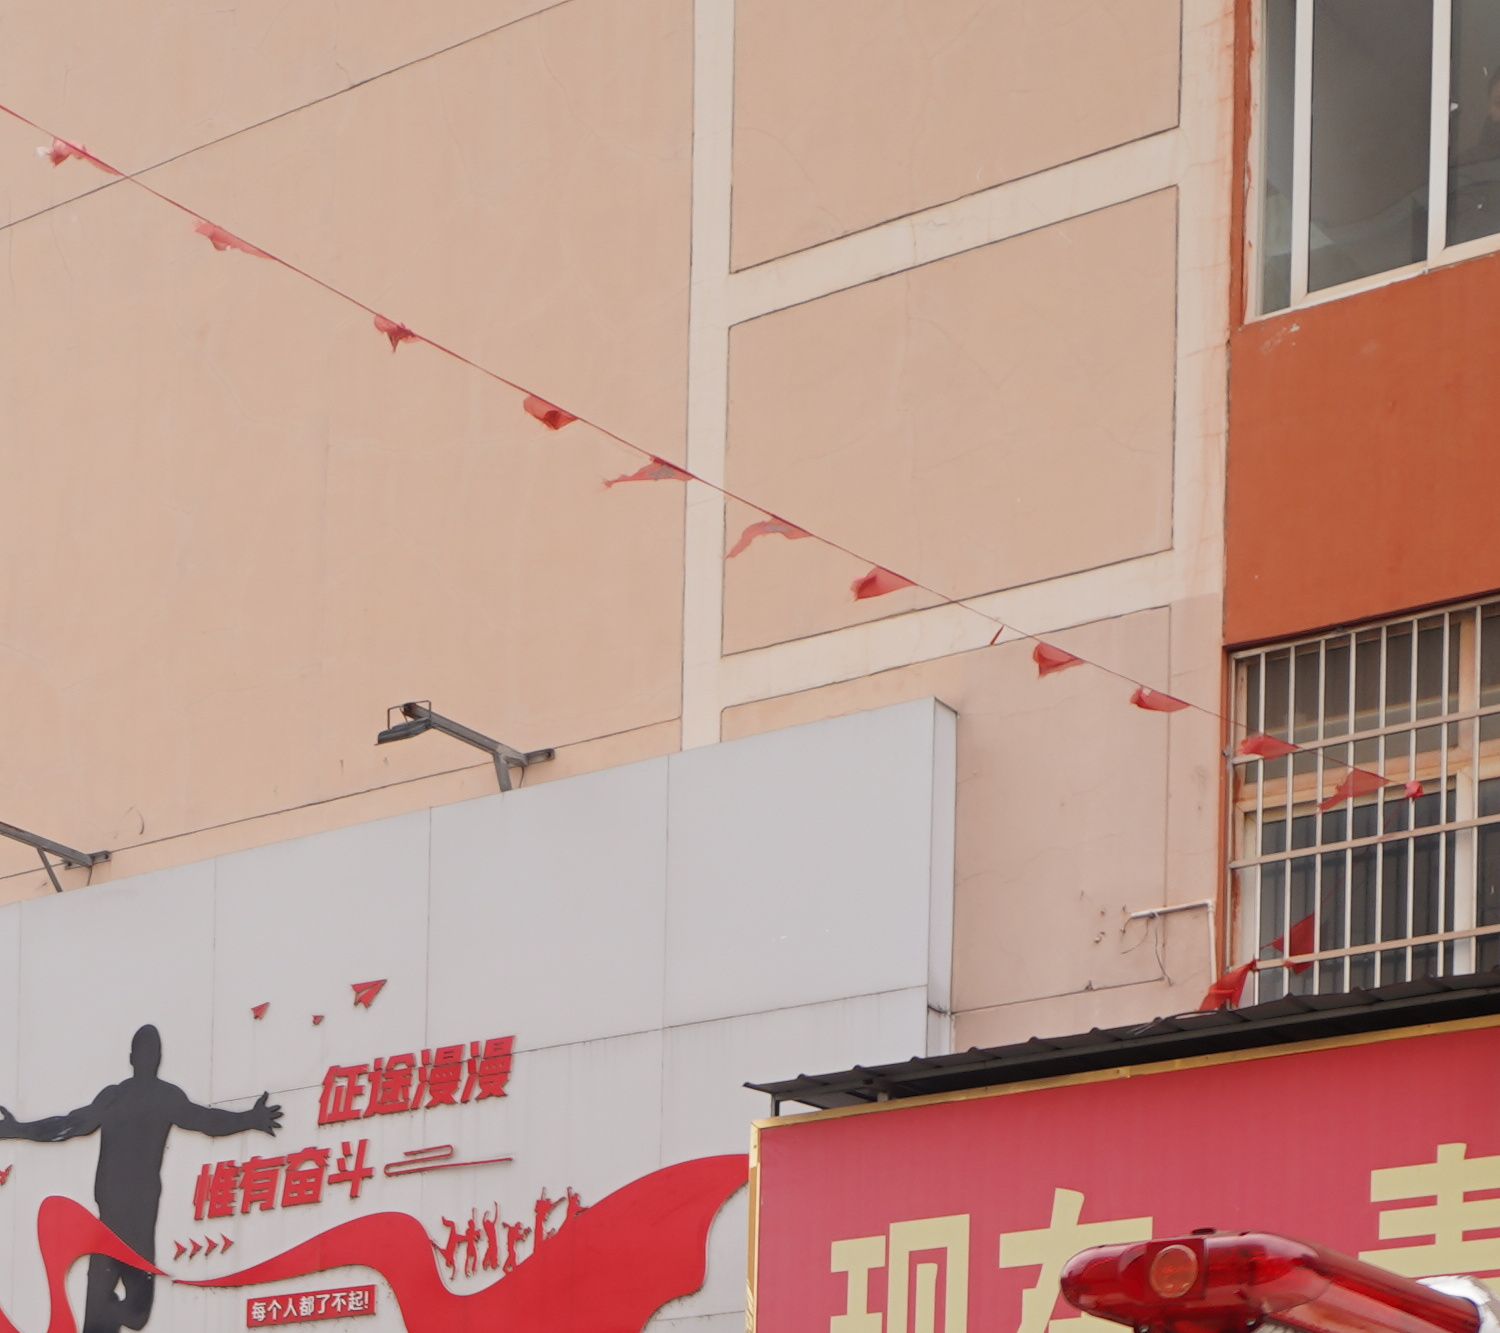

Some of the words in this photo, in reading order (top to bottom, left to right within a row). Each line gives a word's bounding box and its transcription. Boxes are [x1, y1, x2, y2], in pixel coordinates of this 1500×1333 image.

[317, 1035, 515, 1125] 征途漫漫
[193, 1139, 375, 1220] 惟有奋斗
